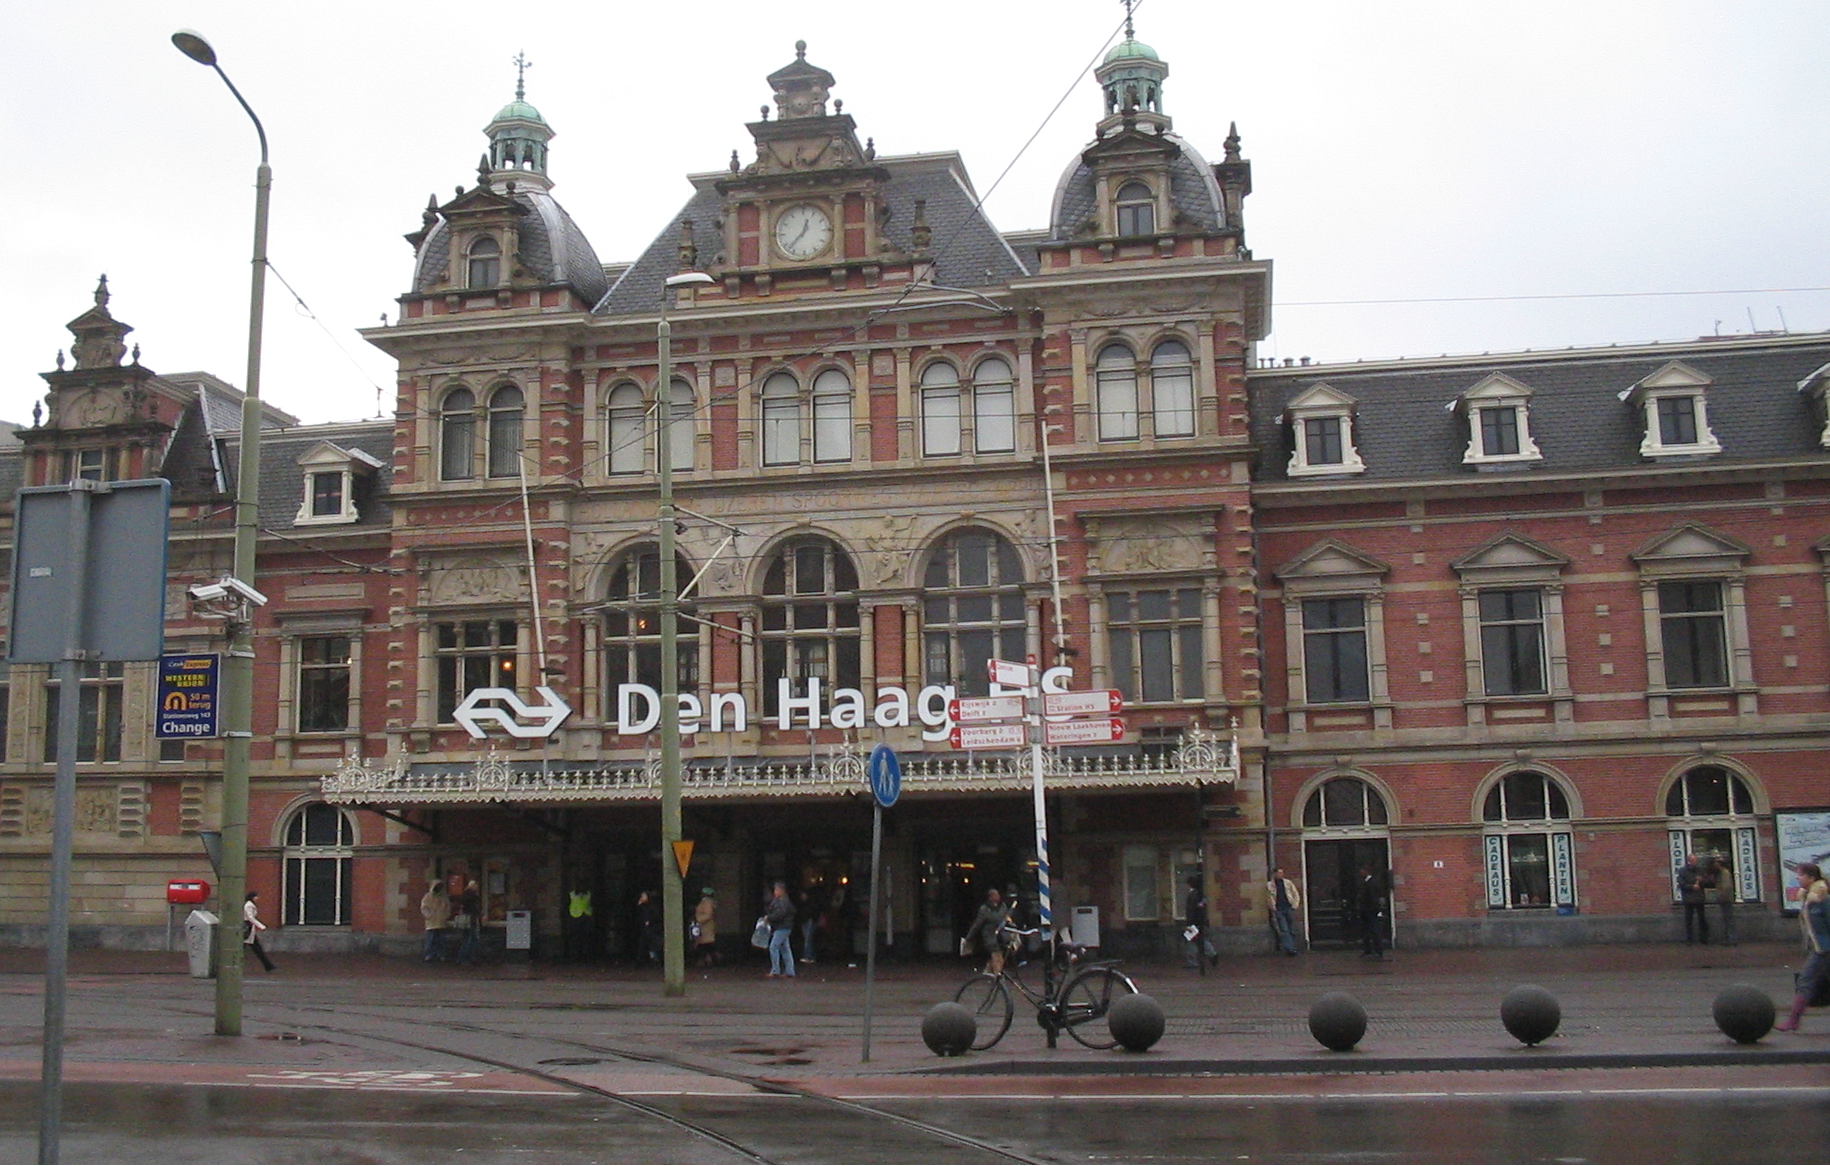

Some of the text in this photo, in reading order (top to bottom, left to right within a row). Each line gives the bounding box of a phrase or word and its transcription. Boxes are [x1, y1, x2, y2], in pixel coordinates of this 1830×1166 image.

[189, 701, 211, 709] terug
[617, 682, 746, 735] Den
[778, 677, 956, 742] Haag
[961, 700, 991, 709] Rijswijk
[1056, 704, 1083, 712] Station
[961, 709, 981, 718] Delft
[162, 721, 210, 735] Change
[962, 728, 998, 737] Voorburg
[962, 736, 1015, 746] Leidschendam
[1557, 835, 1568, 894] PLANTEN
[1742, 829, 1753, 890] CADEAUS
[1489, 837, 1500, 896] CADEAUS
